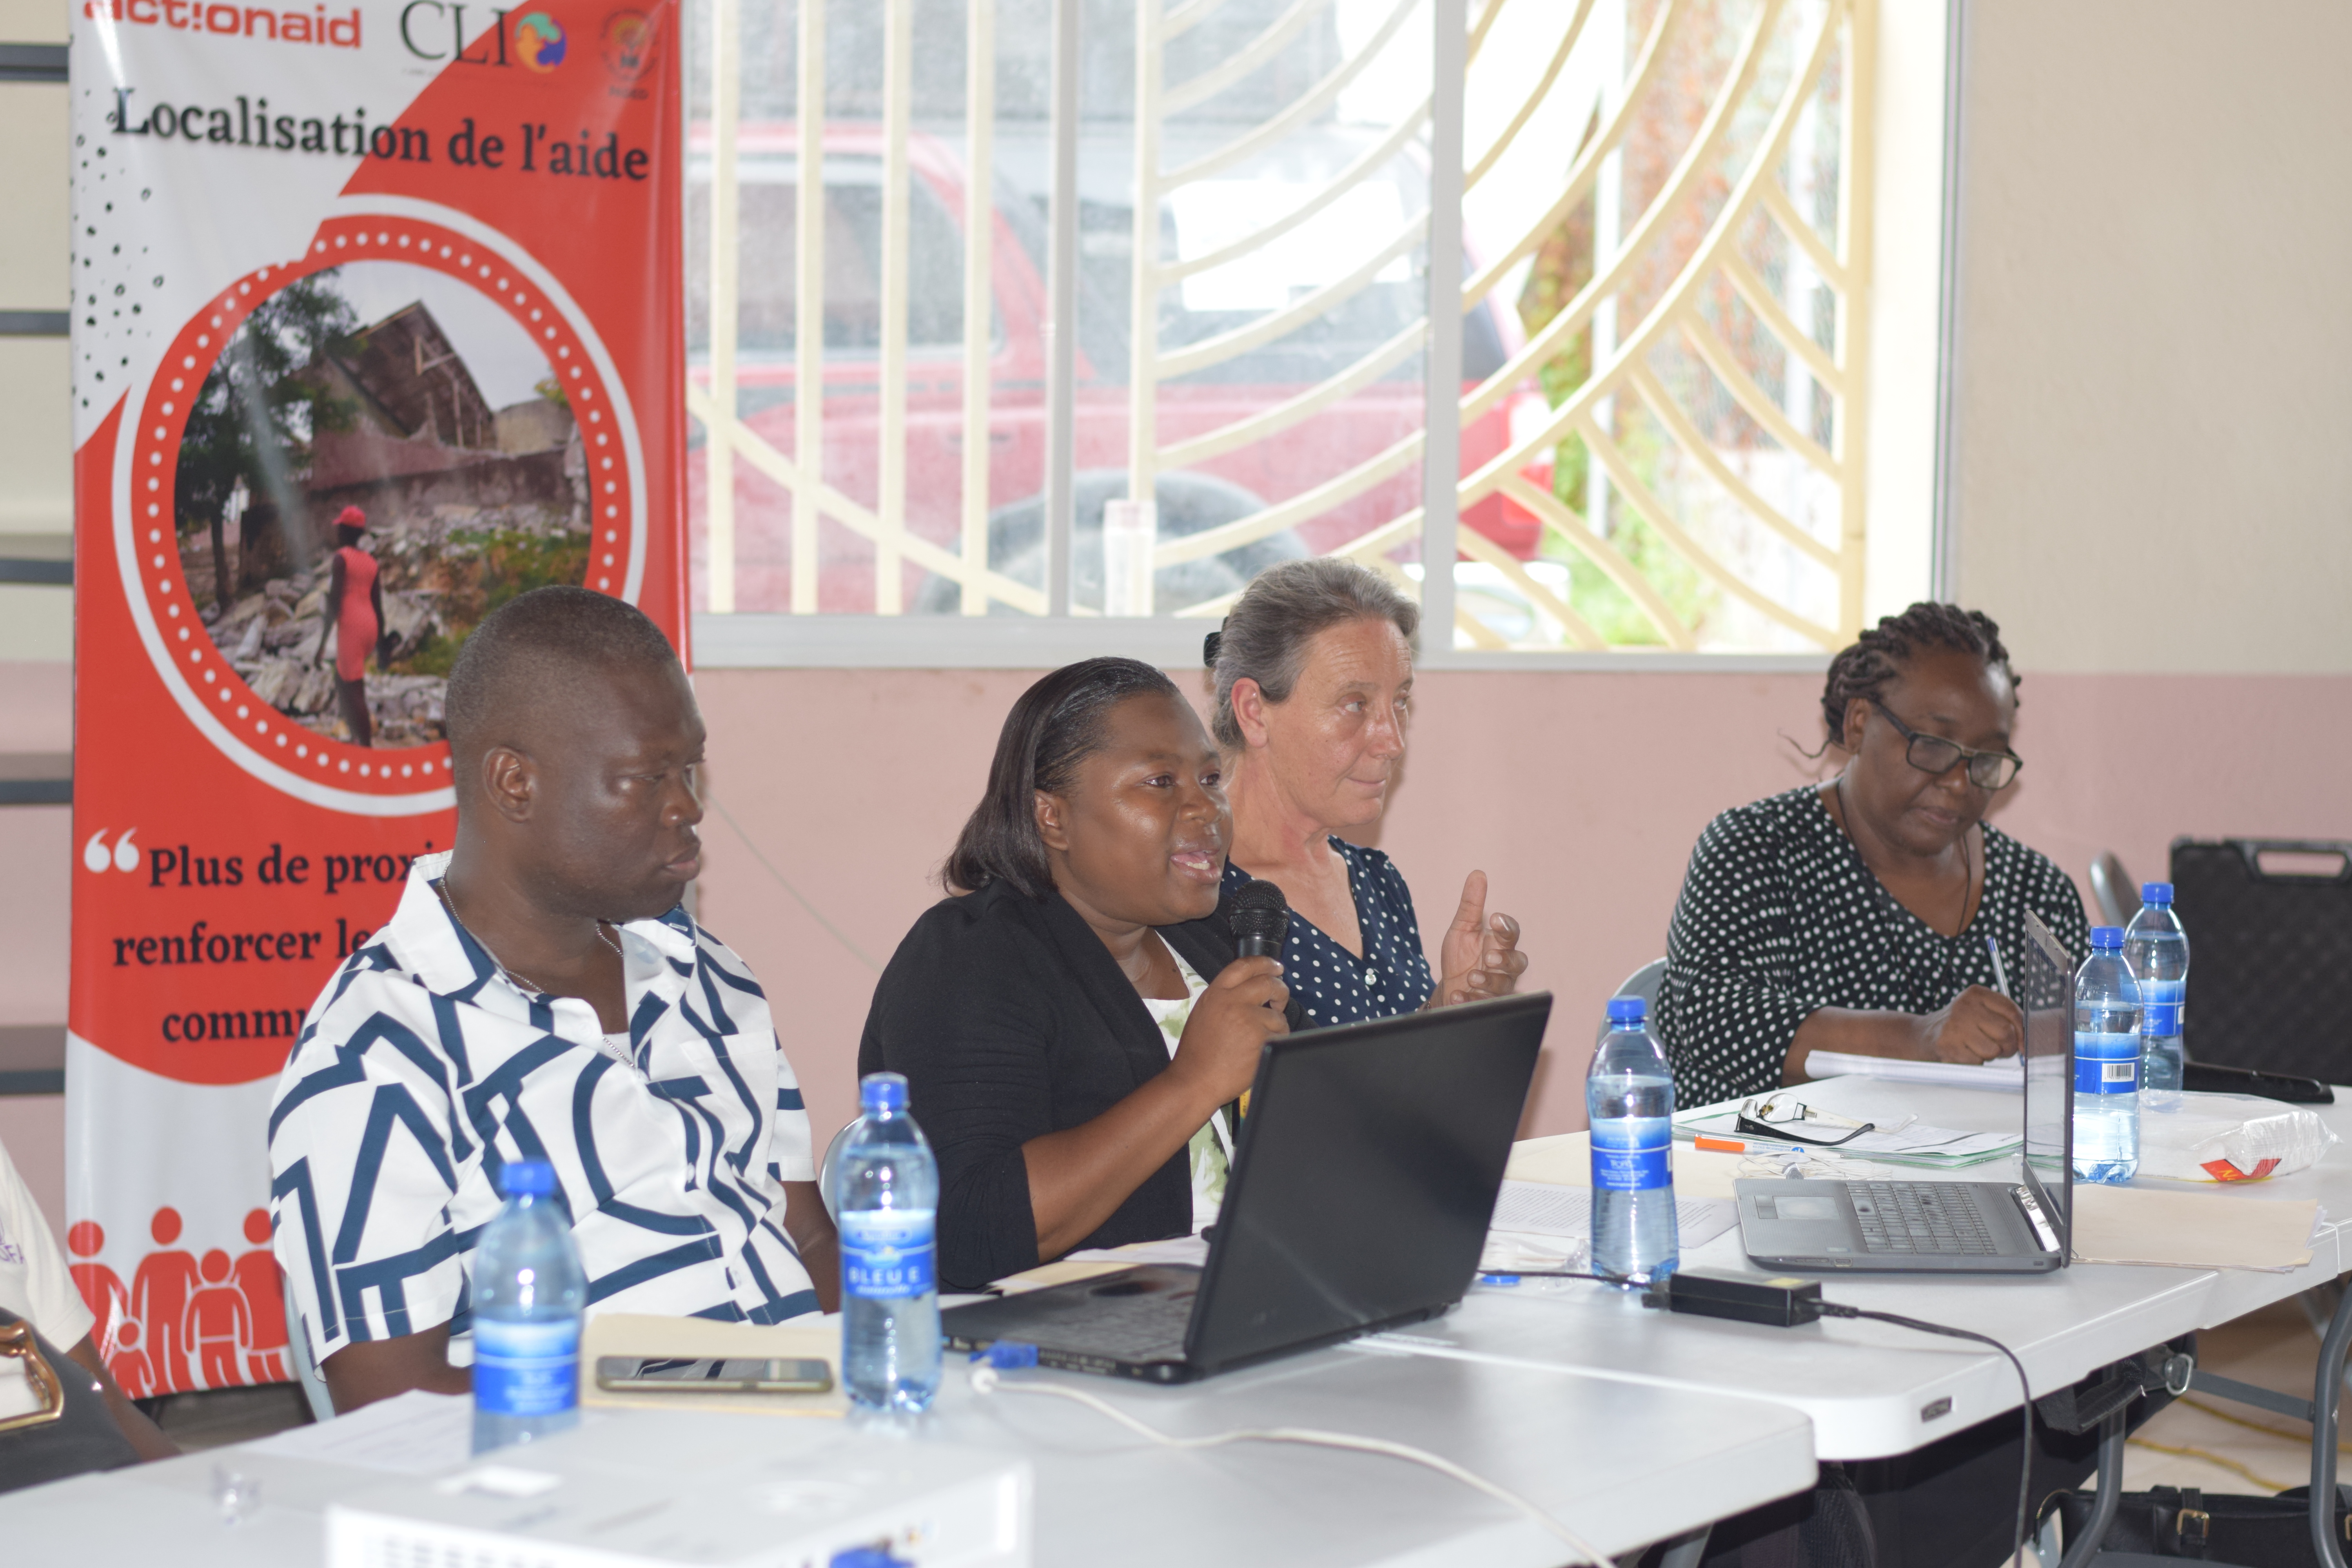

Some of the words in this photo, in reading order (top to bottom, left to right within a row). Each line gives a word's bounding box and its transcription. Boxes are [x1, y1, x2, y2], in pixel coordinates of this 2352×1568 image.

[112, 87, 432, 163] Localisation
[447, 117, 505, 169] de
[520, 122, 650, 181] l'aide
[149, 844, 244, 887] Plus
[257, 842, 310, 885] de
[323, 841, 433, 895] prox
[113, 920, 322, 967] renforcer
